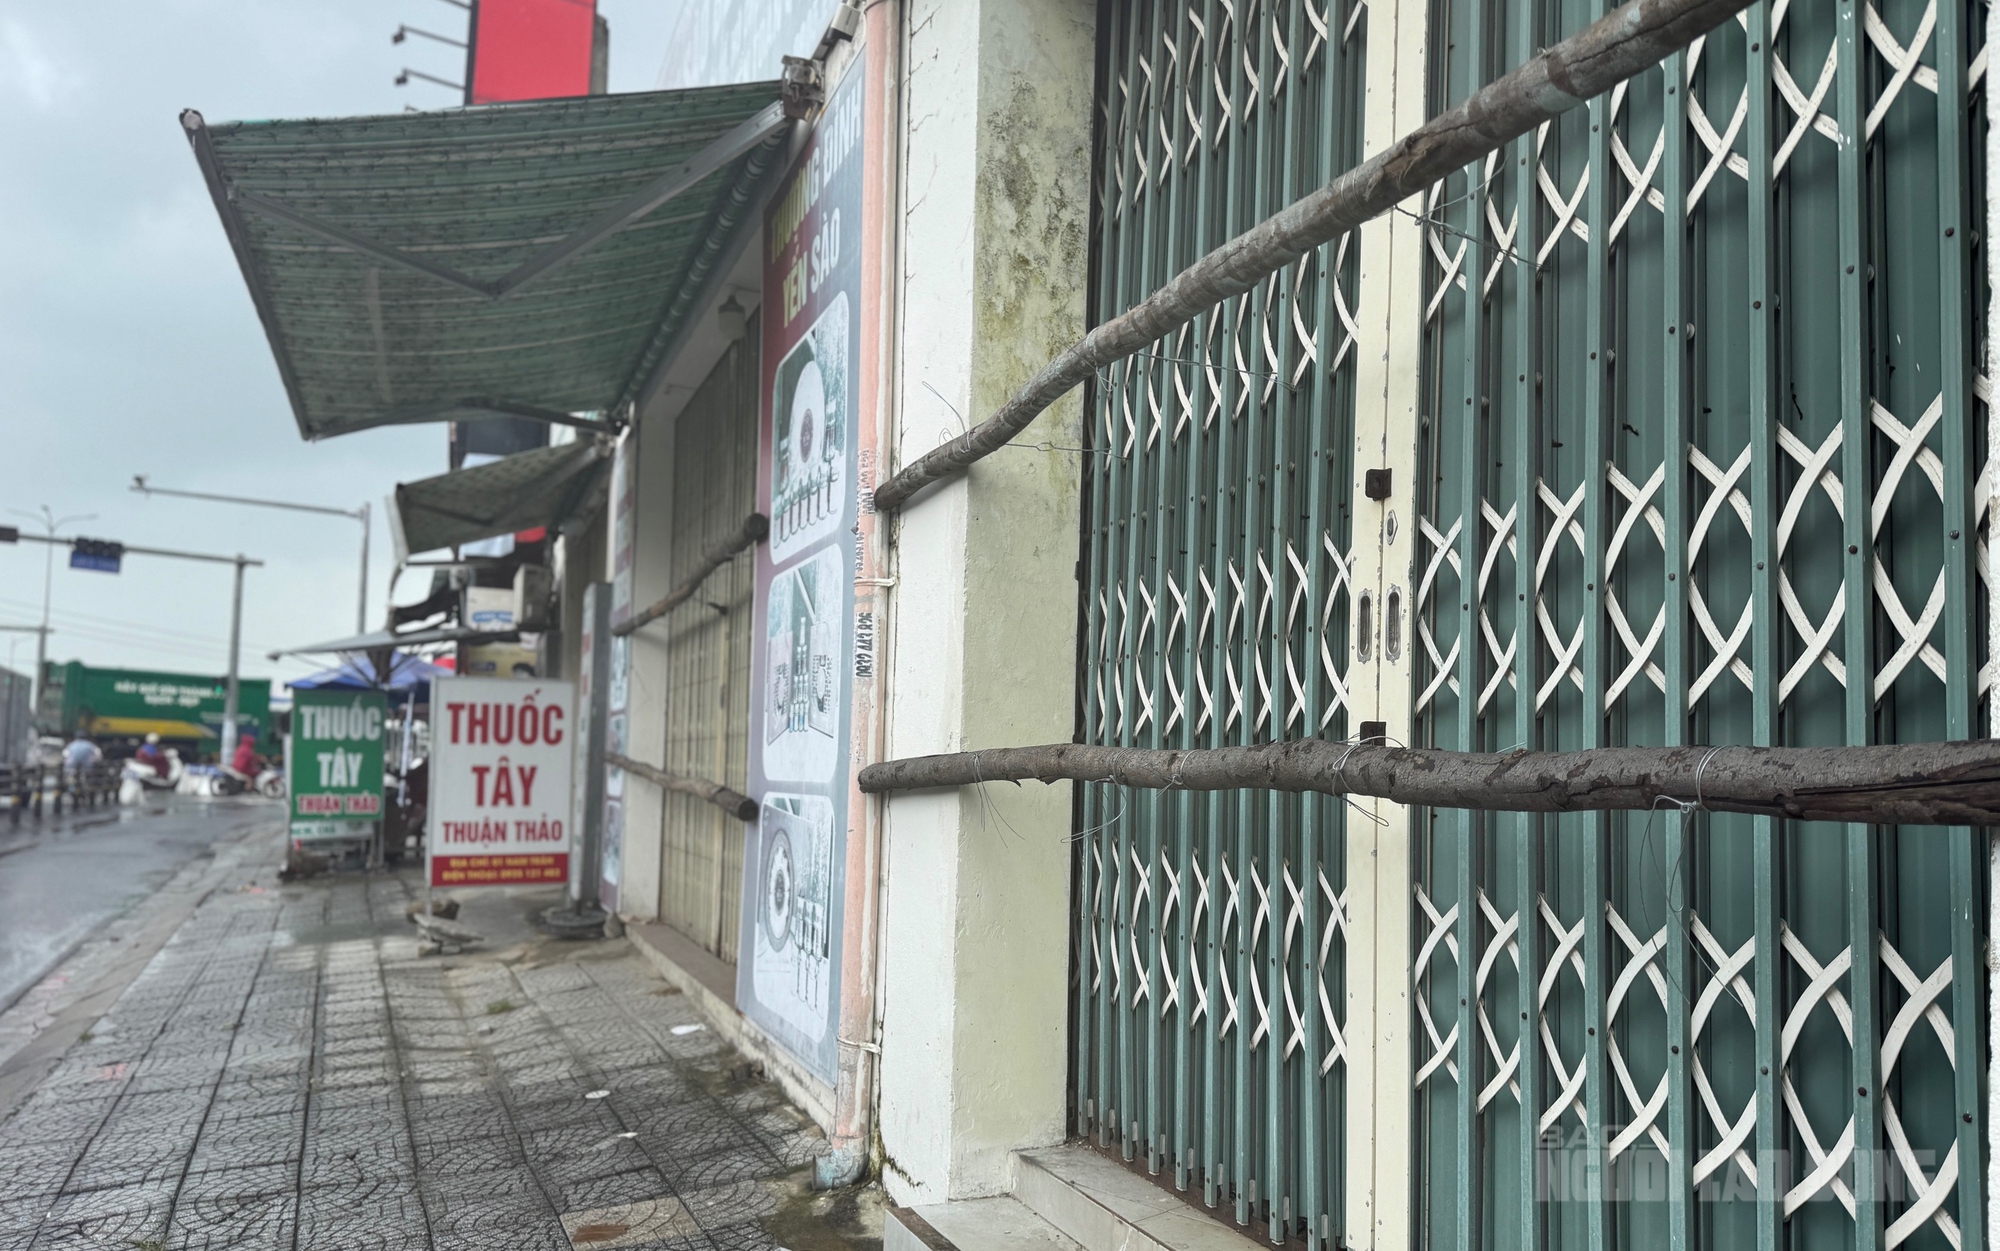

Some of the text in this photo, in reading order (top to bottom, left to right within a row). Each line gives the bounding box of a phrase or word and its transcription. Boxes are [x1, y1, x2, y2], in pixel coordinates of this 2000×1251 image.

[783, 207, 840, 329] YẾN SÀO
[857, 632, 873, 652] 443
[300, 694, 382, 741] THUỐC
[447, 688, 564, 745] THUỐC
[316, 746, 363, 787] TÂY
[471, 756, 537, 806] TÂY
[297, 789, 380, 817] THUẬN THẢO
[442, 813, 563, 848] THUẬN THẢO
